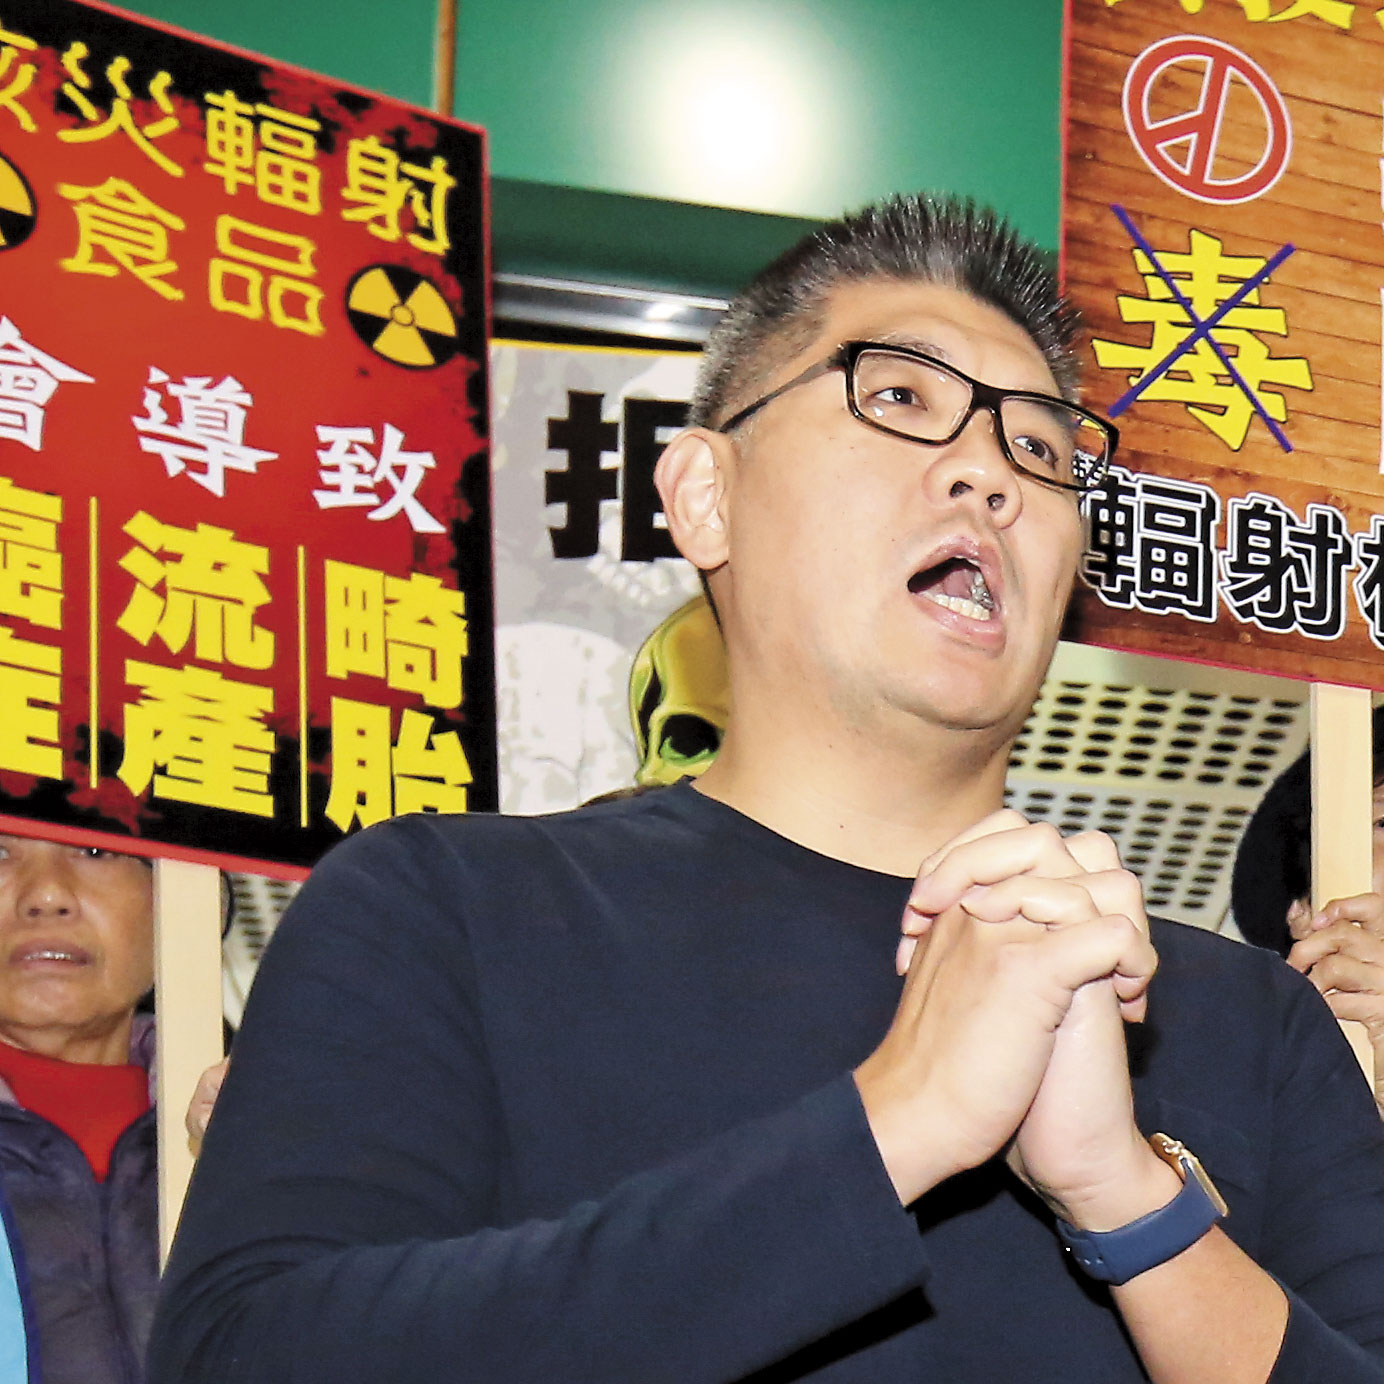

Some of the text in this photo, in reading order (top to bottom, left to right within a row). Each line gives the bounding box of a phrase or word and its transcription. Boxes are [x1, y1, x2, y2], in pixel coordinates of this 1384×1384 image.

[57, 178, 327, 336] 食品
[1092, 229, 1314, 452] 毒
[0, 315, 446, 535] 會導致
[117, 510, 276, 820] 流產
[323, 557, 474, 834] 畸胎
